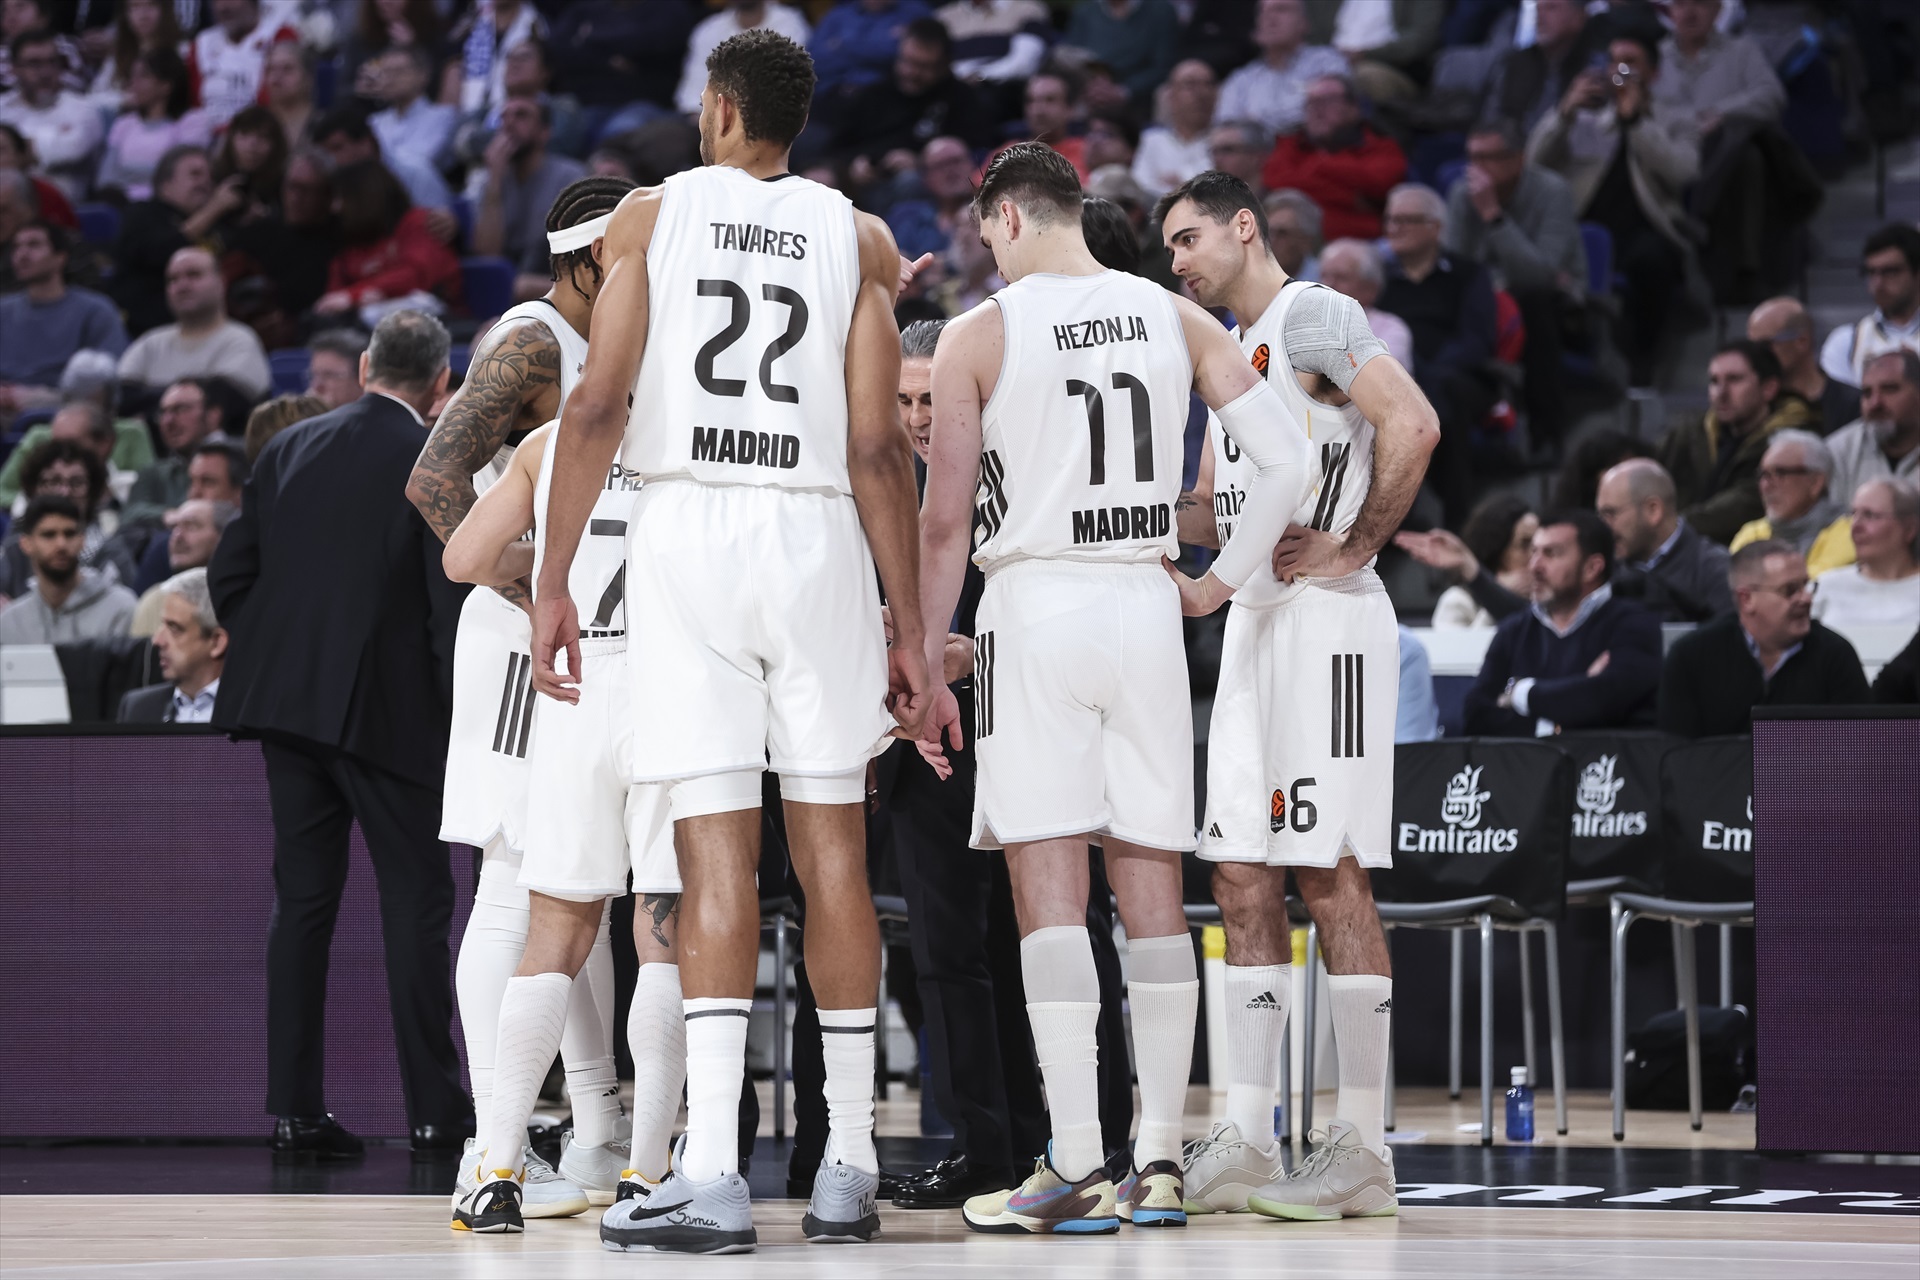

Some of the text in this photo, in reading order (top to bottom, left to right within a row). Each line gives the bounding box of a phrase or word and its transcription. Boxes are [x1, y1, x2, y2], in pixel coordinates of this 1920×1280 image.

[710, 222, 807, 261] TAVARES
[694, 279, 809, 405] 22
[1053, 316, 1149, 351] HEZONJA
[691, 426, 801, 469] MADRID
[1066, 372, 1155, 486] 11
[1072, 503, 1170, 544] MADRID
[1290, 777, 1318, 833] 6
[1398, 822, 1519, 853] Emirates
